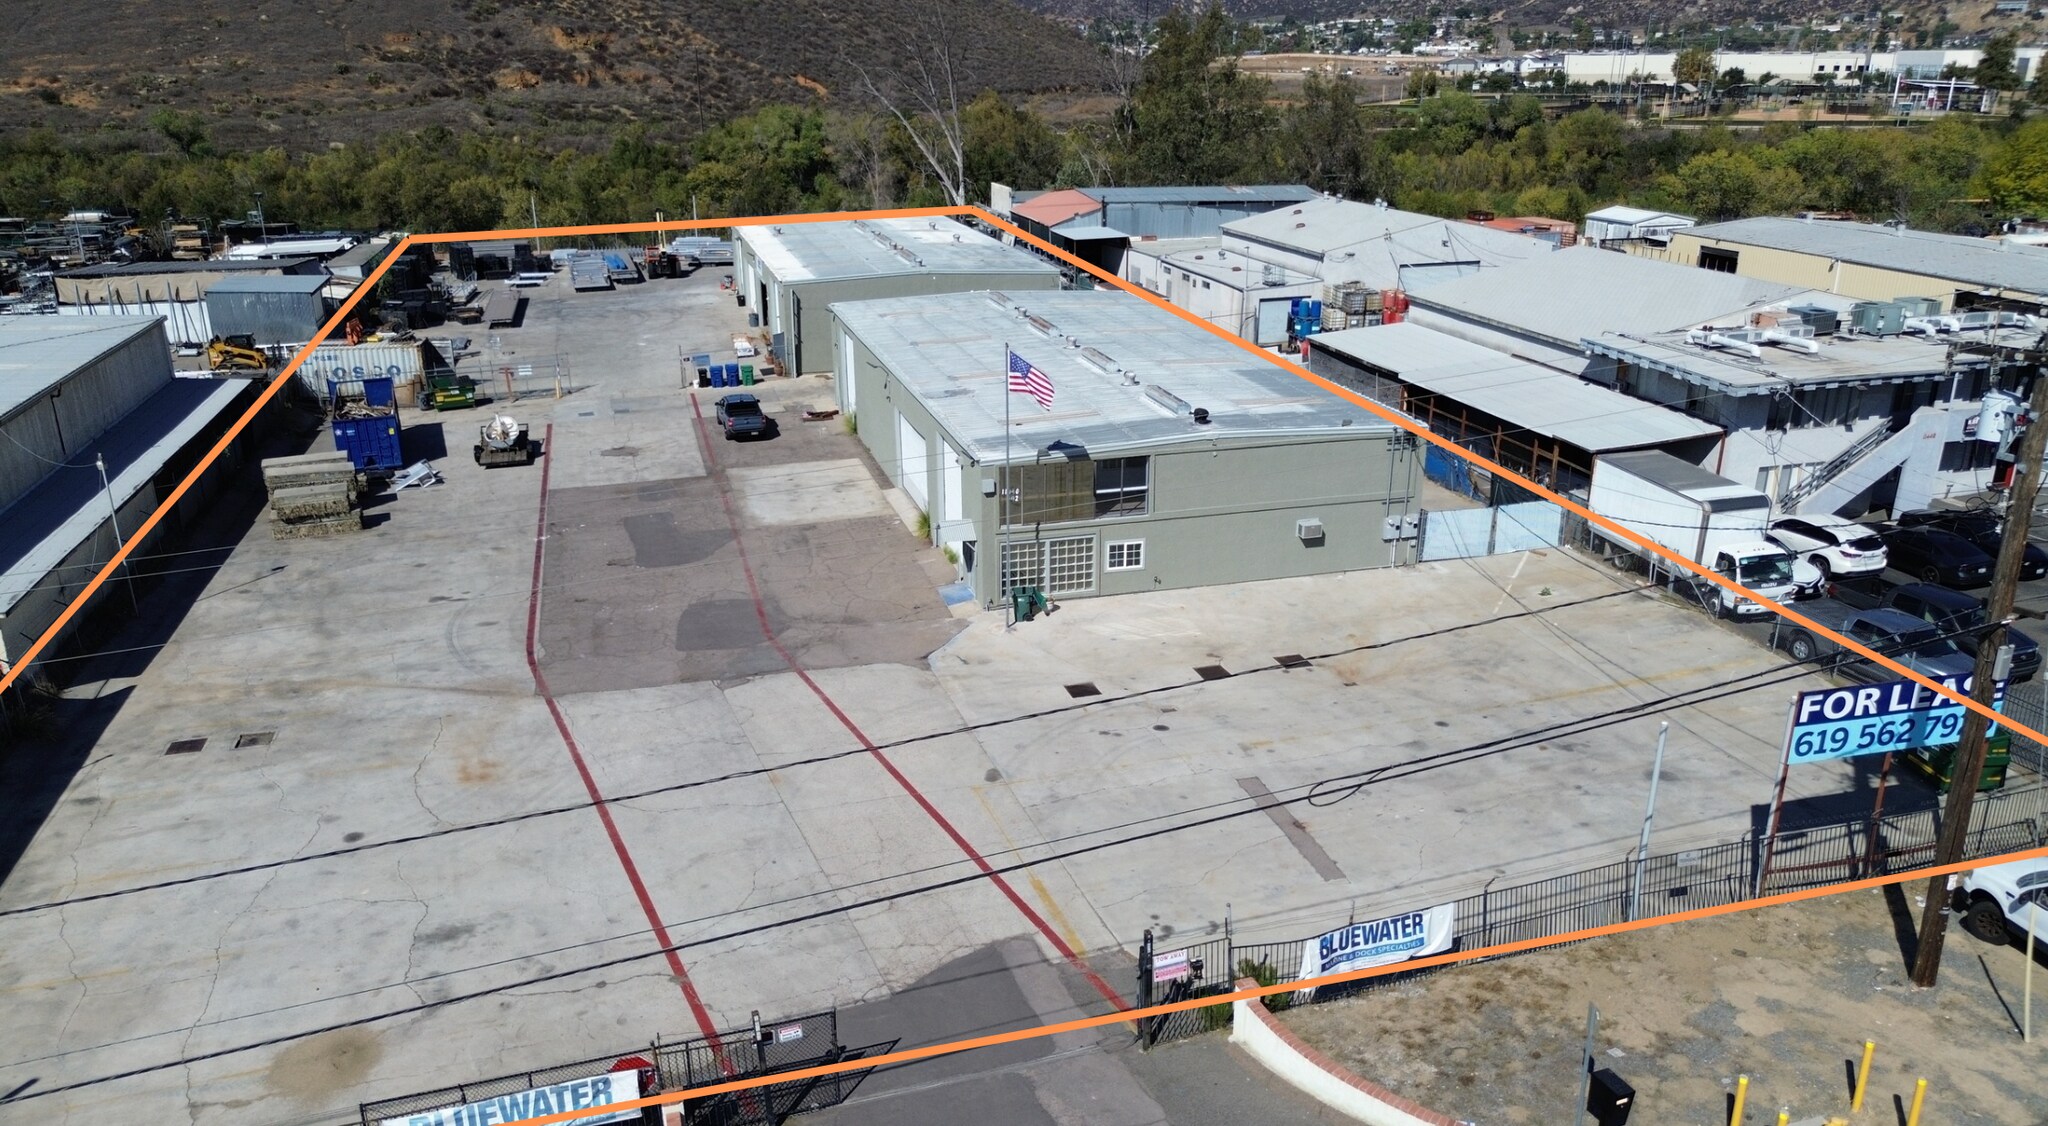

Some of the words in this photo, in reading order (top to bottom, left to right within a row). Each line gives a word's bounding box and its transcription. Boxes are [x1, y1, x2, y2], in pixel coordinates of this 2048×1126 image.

[1799, 685, 1881, 724] FOR
[1794, 727, 1849, 757] 619
[1857, 718, 1916, 750] 562
[1319, 912, 1424, 961] BLUEWATER
[1355, 948, 1377, 957] DOCK
[409, 1076, 613, 1126] UEWATER
